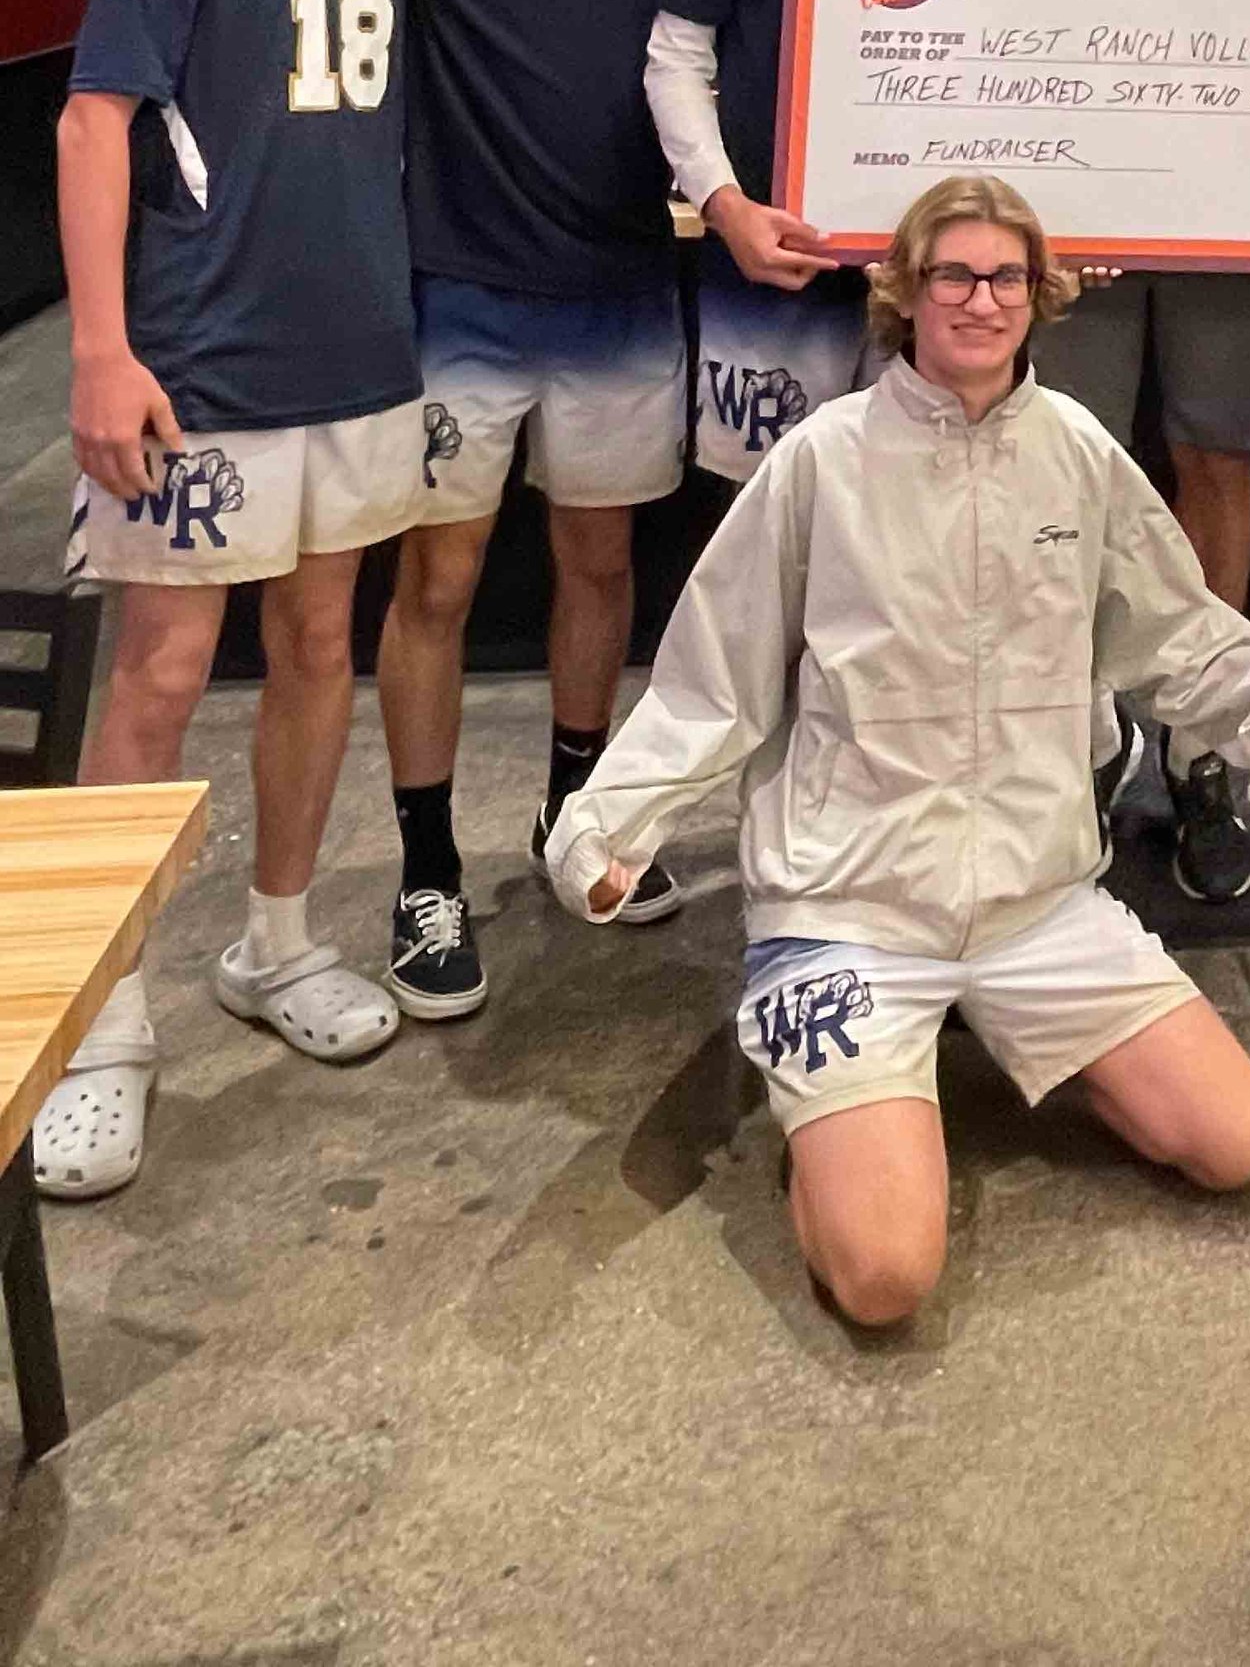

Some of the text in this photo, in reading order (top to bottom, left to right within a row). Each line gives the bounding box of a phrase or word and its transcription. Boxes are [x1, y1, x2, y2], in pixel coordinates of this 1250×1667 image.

[860, 31, 965, 45] PAY TO THE
[980, 27, 1071, 57] WEST
[1085, 25, 1172, 62] RANCH
[860, 47, 949, 61] ORDER OF
[867, 67, 963, 101] THREE
[978, 77, 1094, 104] HUNDRED
[853, 152, 909, 166] MEMO
[922, 138, 1090, 168] FUNDRAISER
